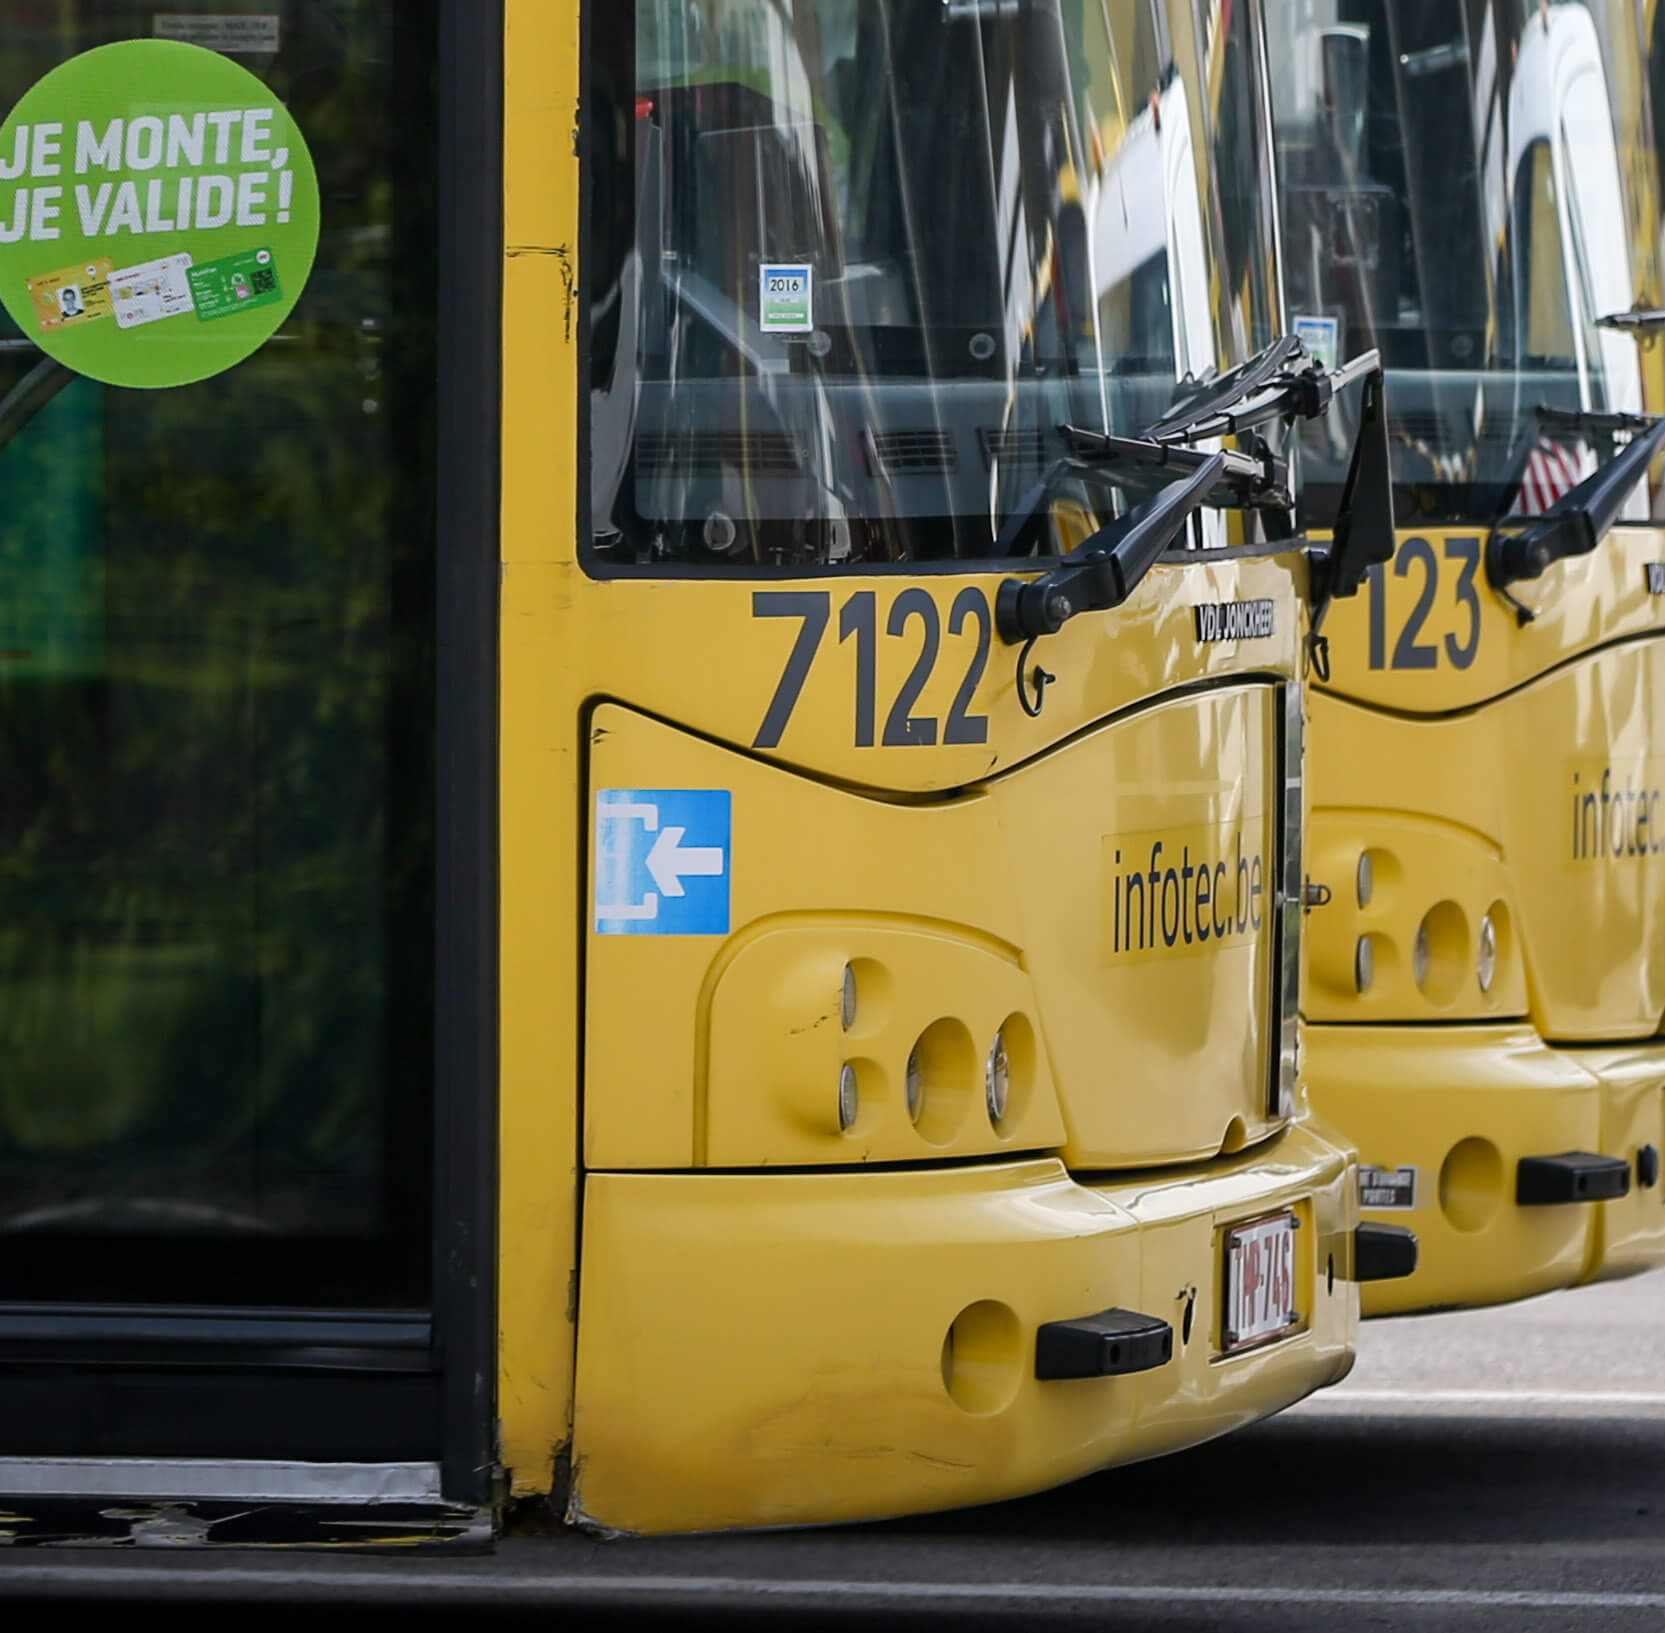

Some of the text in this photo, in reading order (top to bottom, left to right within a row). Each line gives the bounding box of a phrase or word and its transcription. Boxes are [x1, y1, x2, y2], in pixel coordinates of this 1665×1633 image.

[74, 108, 289, 174] MONTE,
[769, 278, 800, 292] 2016
[1199, 605, 1222, 641] VDL
[1364, 537, 1480, 671] 123
[751, 586, 992, 749] 7122
[1113, 831, 1262, 953] infotec.be
